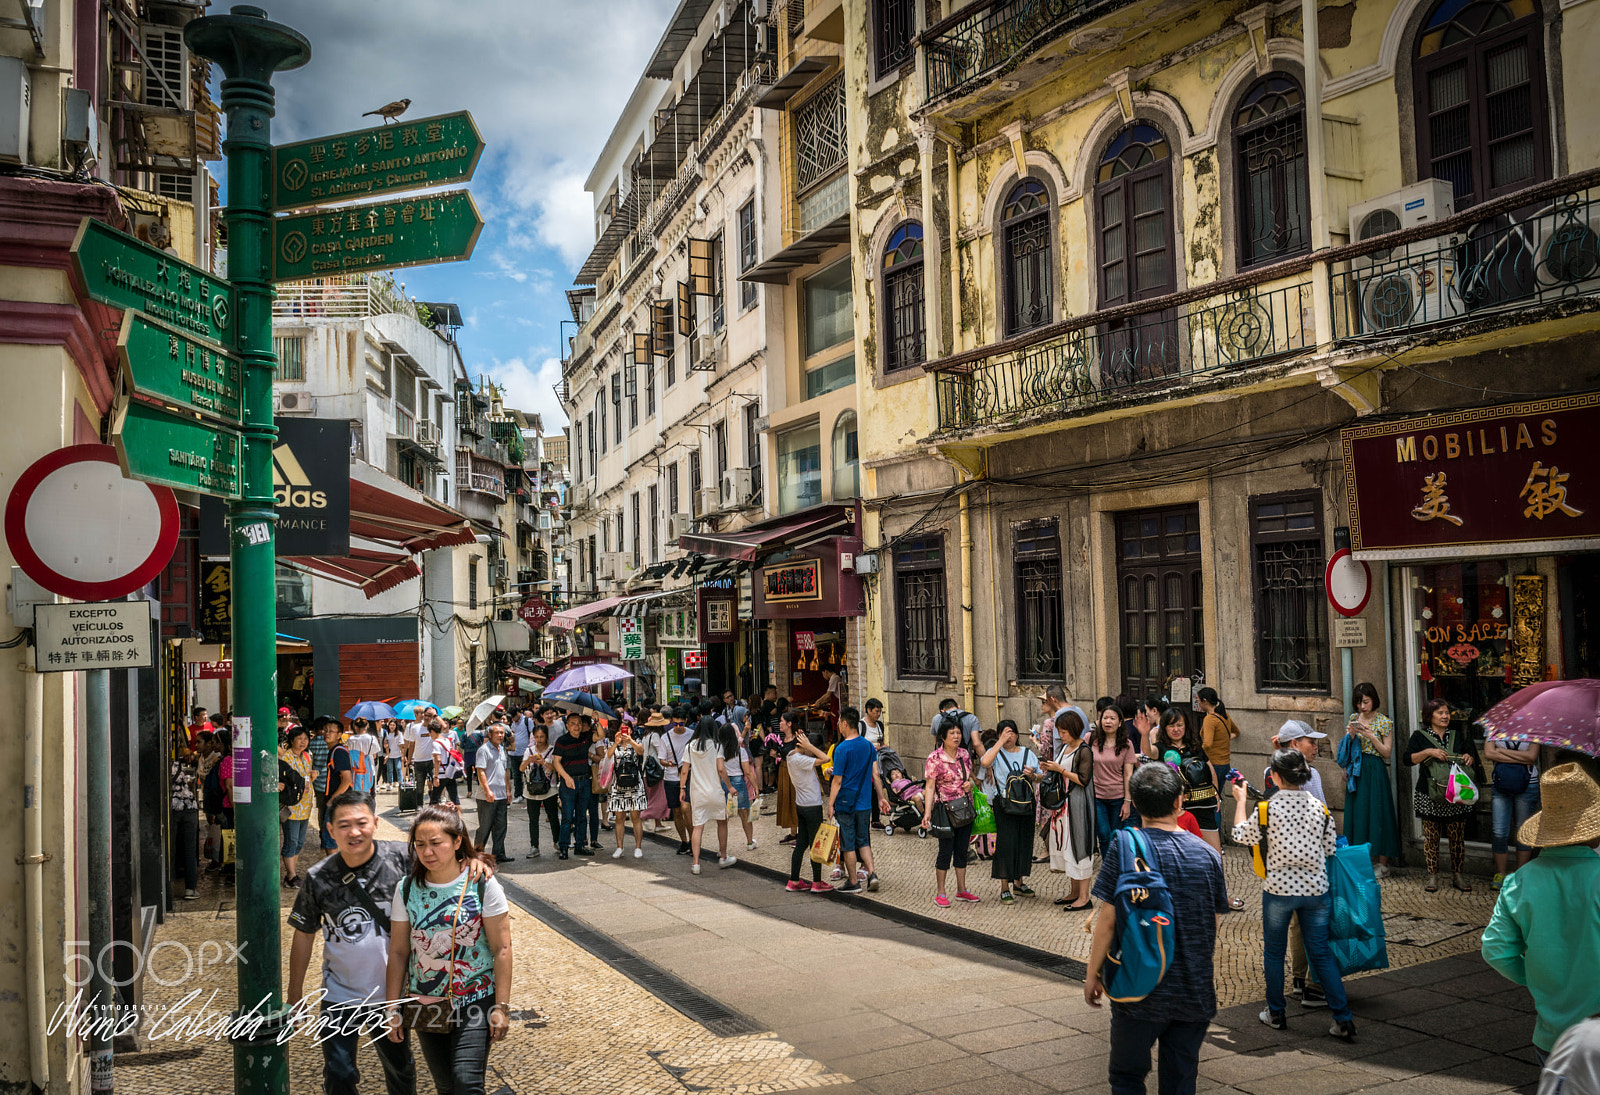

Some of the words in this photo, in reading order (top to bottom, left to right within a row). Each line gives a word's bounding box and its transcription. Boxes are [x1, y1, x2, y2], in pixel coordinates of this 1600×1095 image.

[310, 122, 442, 164] 聖安多尼教堂
[311, 166, 350, 183] IGREJA
[353, 164, 368, 175] DE
[371, 157, 411, 173] SANTO
[311, 187, 326, 198] St.
[328, 177, 383, 195] Anthony's
[386, 169, 427, 185] Church
[311, 202, 436, 236] 東方基金會會址
[311, 241, 342, 255] CASA
[344, 233, 394, 250] GARDEN
[311, 259, 340, 271] Casa
[343, 253, 386, 267] Garden
[157, 259, 210, 297] 大炮台
[165, 288, 179, 304] DO
[180, 295, 210, 317] MONTE
[146, 299, 174, 320] Mount
[174, 310, 210, 334] Fortress
[182, 368, 206, 388] MUSEU
[206, 379, 216, 391] DE
[1396, 419, 1557, 463] MOBILIAS
[199, 473, 219, 487] Public
[219, 477, 237, 491] Toilet
[69, 609, 117, 618] EXCEPTO
[72, 620, 124, 632] VEÍCULOS
[1427, 625, 1450, 643] ON
[1456, 622, 1508, 642] SALE
[61, 634, 134, 646] AUTORIZADOS
[624, 633, 643, 660] 藥房
[48, 648, 140, 664] 特許車輛除外
